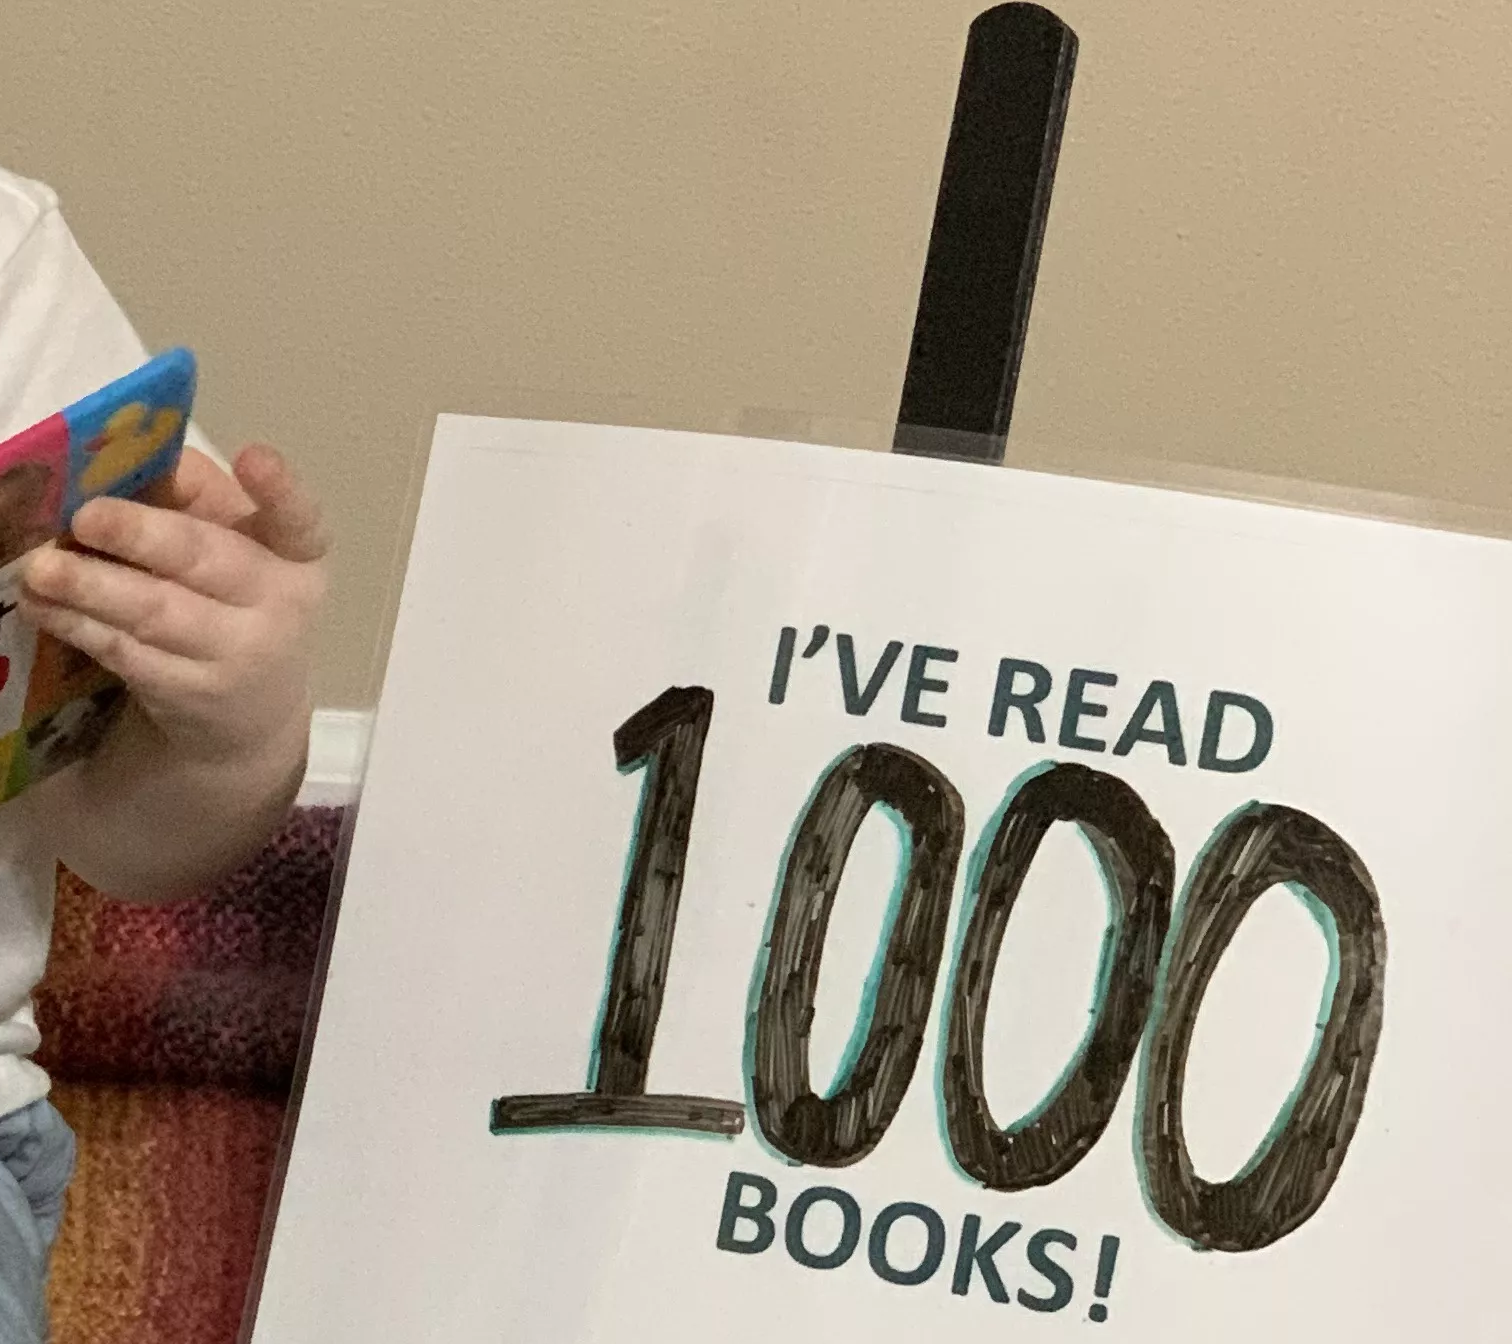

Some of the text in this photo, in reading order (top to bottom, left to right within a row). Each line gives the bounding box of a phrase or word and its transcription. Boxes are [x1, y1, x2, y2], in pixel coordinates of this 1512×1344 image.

[767, 623, 1276, 775] I'VE READ
[488, 684, 1388, 1254] 1000
[715, 1169, 1121, 1324] BOOKS!
